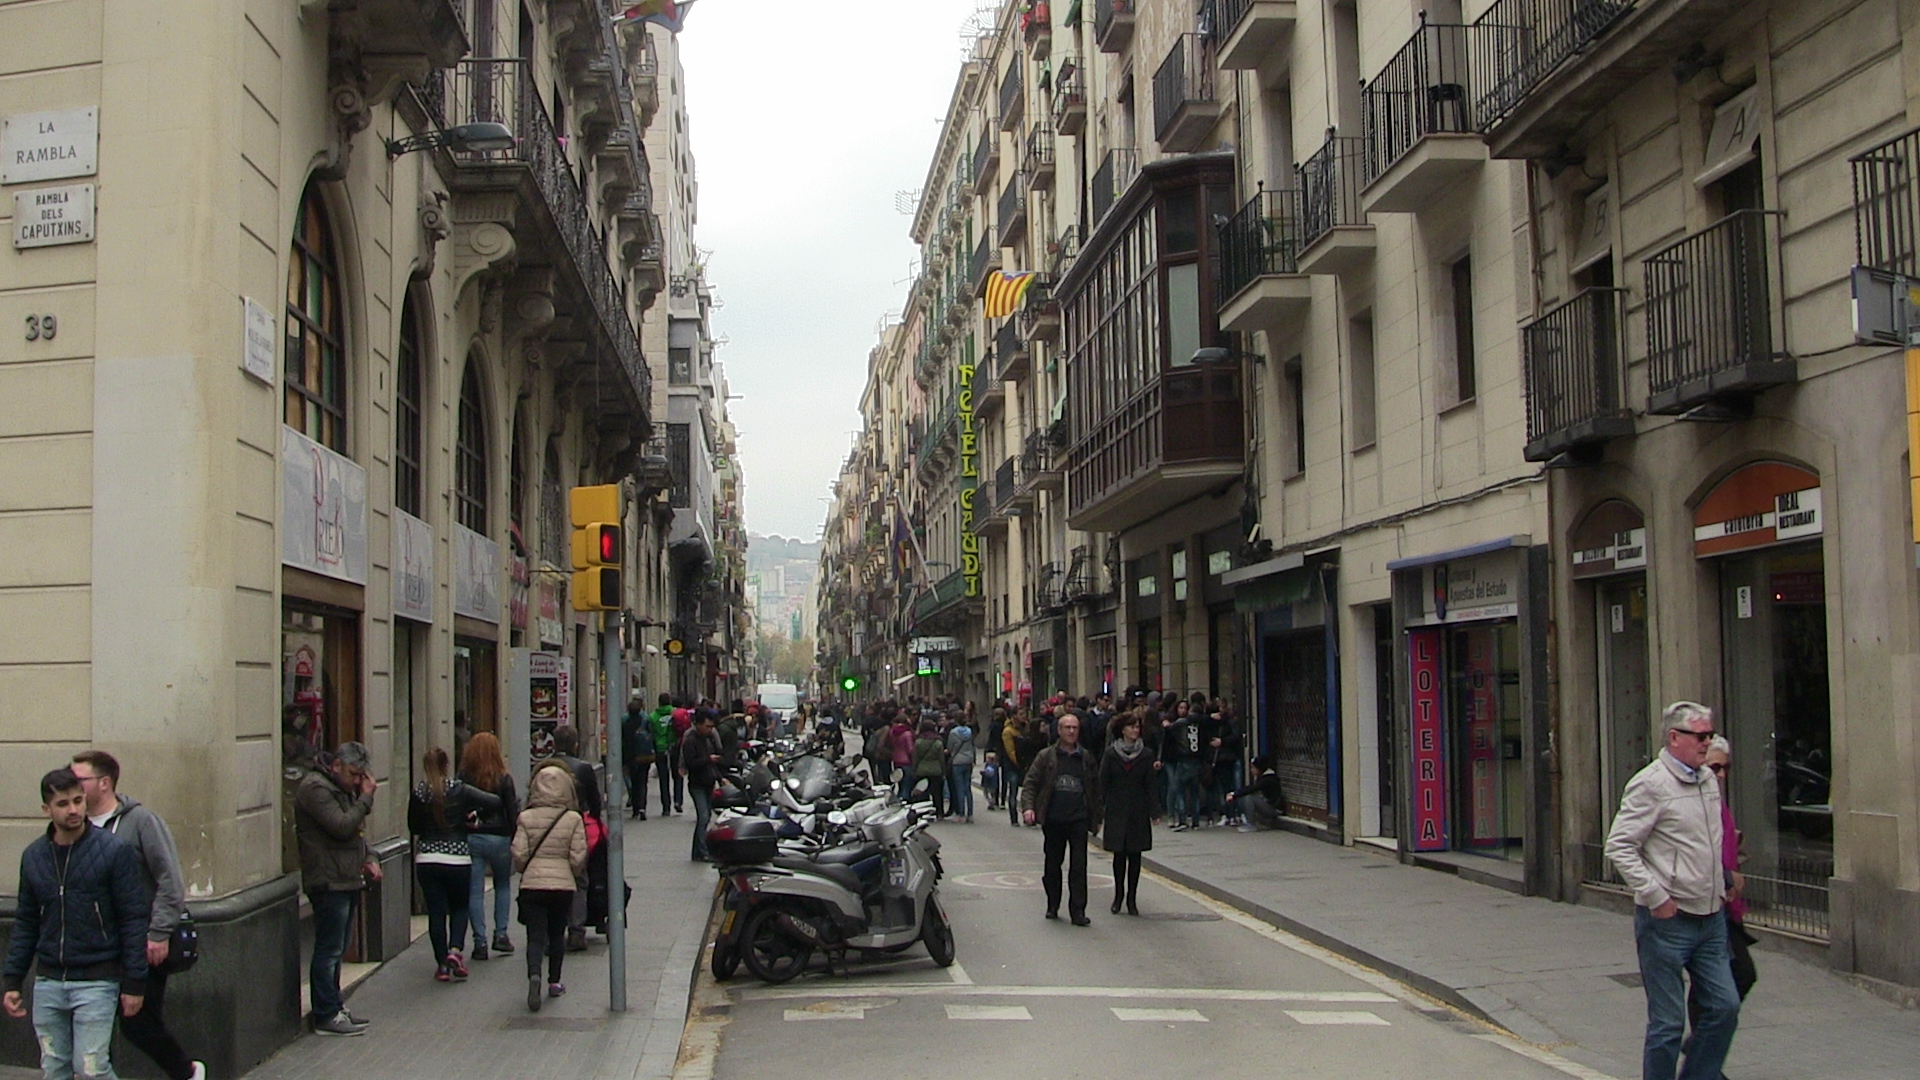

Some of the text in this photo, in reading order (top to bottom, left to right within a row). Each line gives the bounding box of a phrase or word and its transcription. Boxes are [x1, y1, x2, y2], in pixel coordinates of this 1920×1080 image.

[39, 122, 55, 134] LA
[1725, 107, 1745, 152] A
[16, 145, 77, 164] RAMBLA
[36, 193, 69, 206] RAMBLA
[41, 208, 63, 220] DELS
[22, 220, 82, 240] CAPUTXINS
[25, 313, 57, 341] 39
[1779, 491, 1799, 512] IDEAL
[1724, 513, 1763, 534] cafeteria
[1779, 510, 1815, 530] RESTAURANT
[1476, 581, 1484, 598] del
[1486, 578, 1506, 597] Estado
[1417, 640, 1438, 842] LOTERIA
